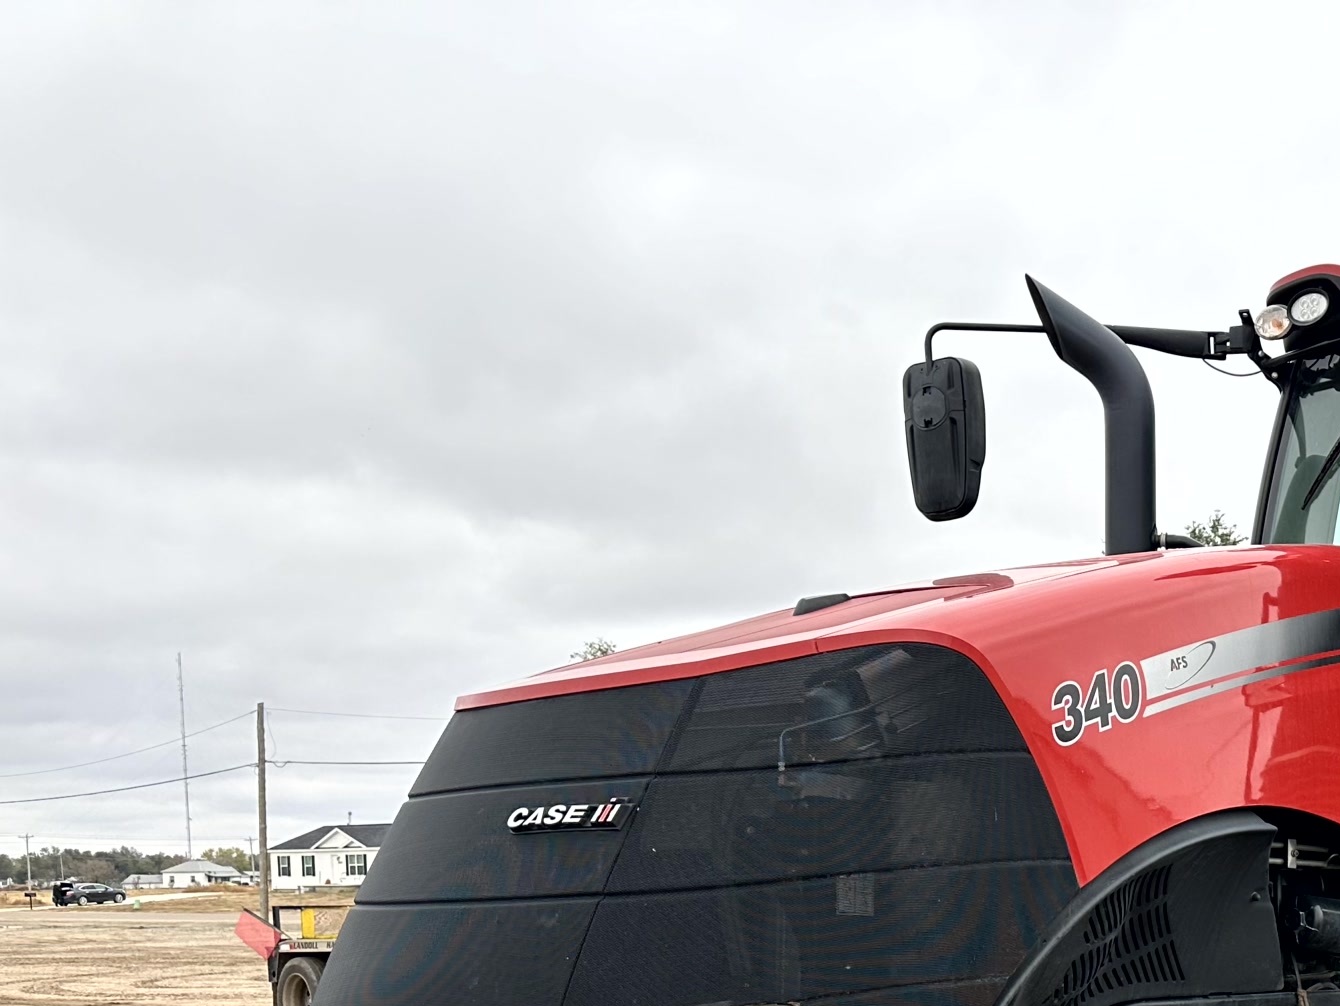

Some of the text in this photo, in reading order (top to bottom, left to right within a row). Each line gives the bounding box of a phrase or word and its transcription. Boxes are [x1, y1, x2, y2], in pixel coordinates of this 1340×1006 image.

[1170, 656, 1188, 671] AFS
[1052, 660, 1142, 746] 340
[507, 805, 588, 828] CASE
